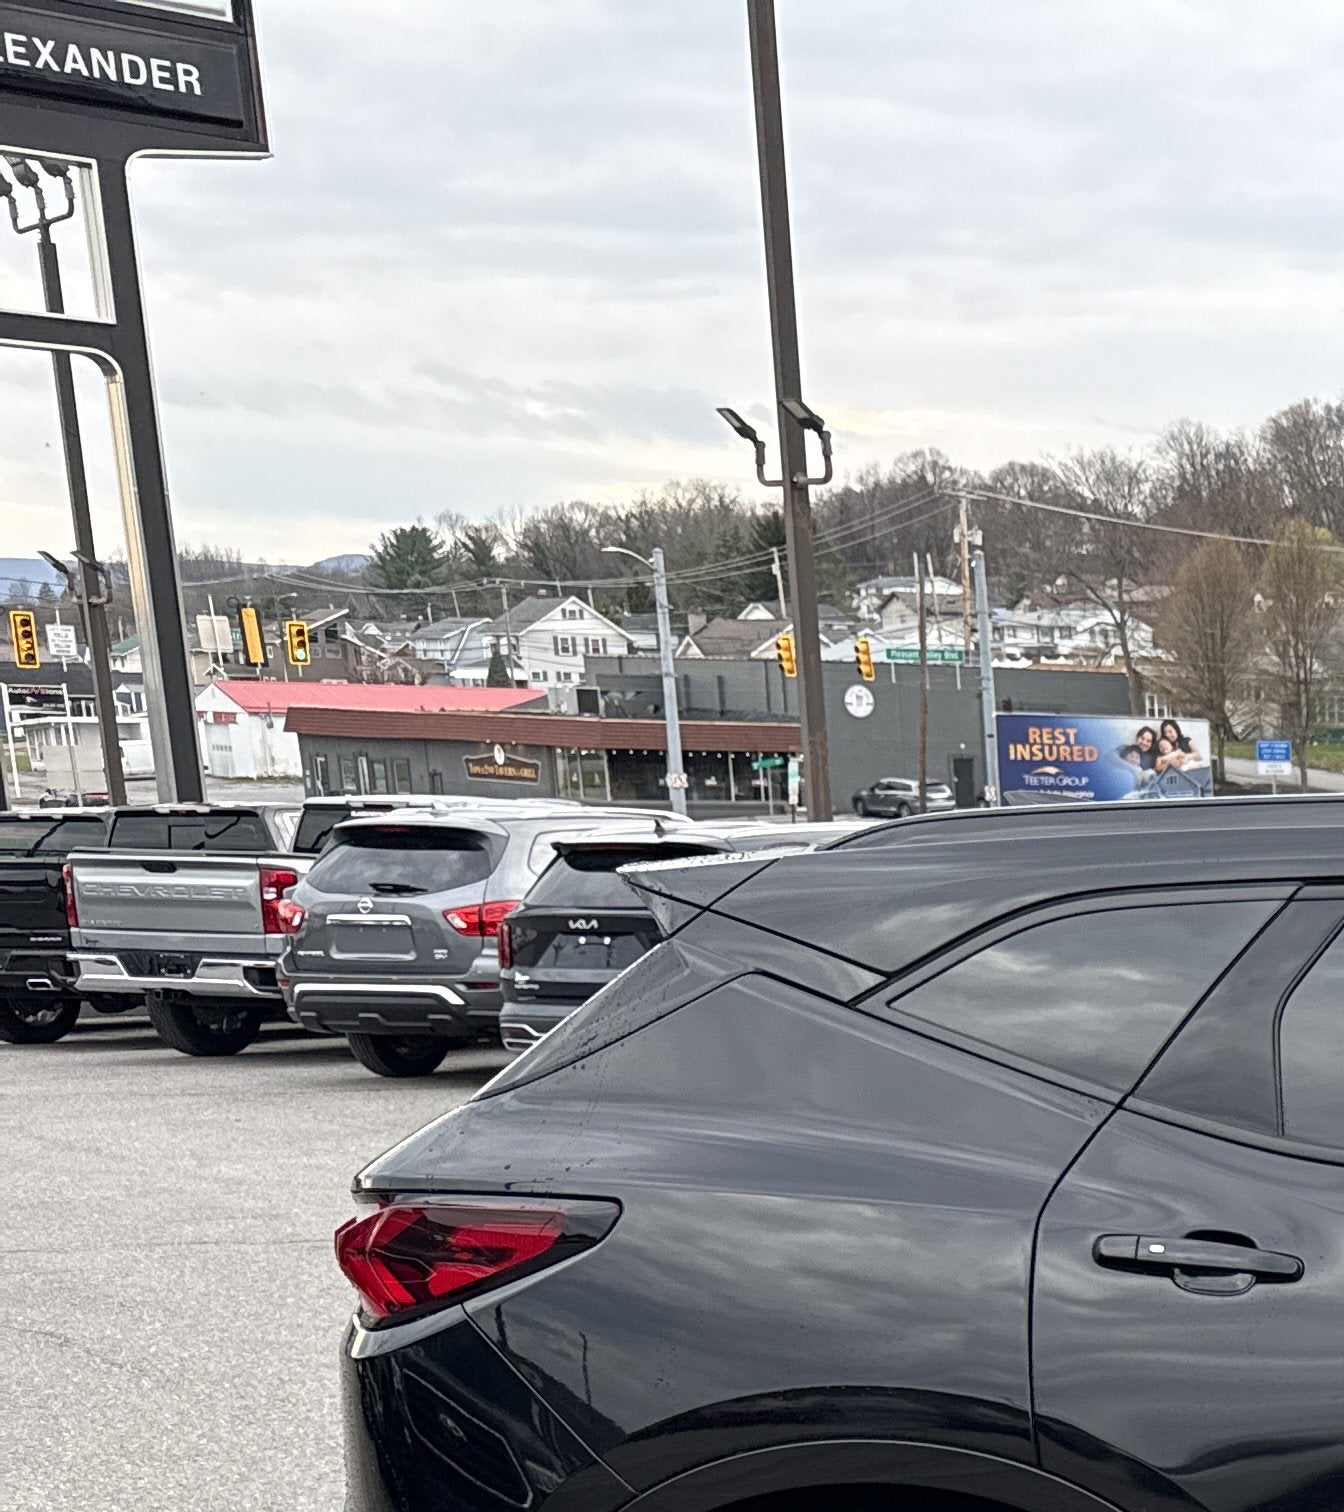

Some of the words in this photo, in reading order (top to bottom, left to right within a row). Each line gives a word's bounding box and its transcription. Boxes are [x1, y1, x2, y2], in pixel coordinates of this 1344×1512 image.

[0, 32, 202, 96] EXANDER
[1028, 727, 1077, 745] REST
[1008, 744, 1099, 762] INSURED
[1056, 775, 1089, 787] GROUP
